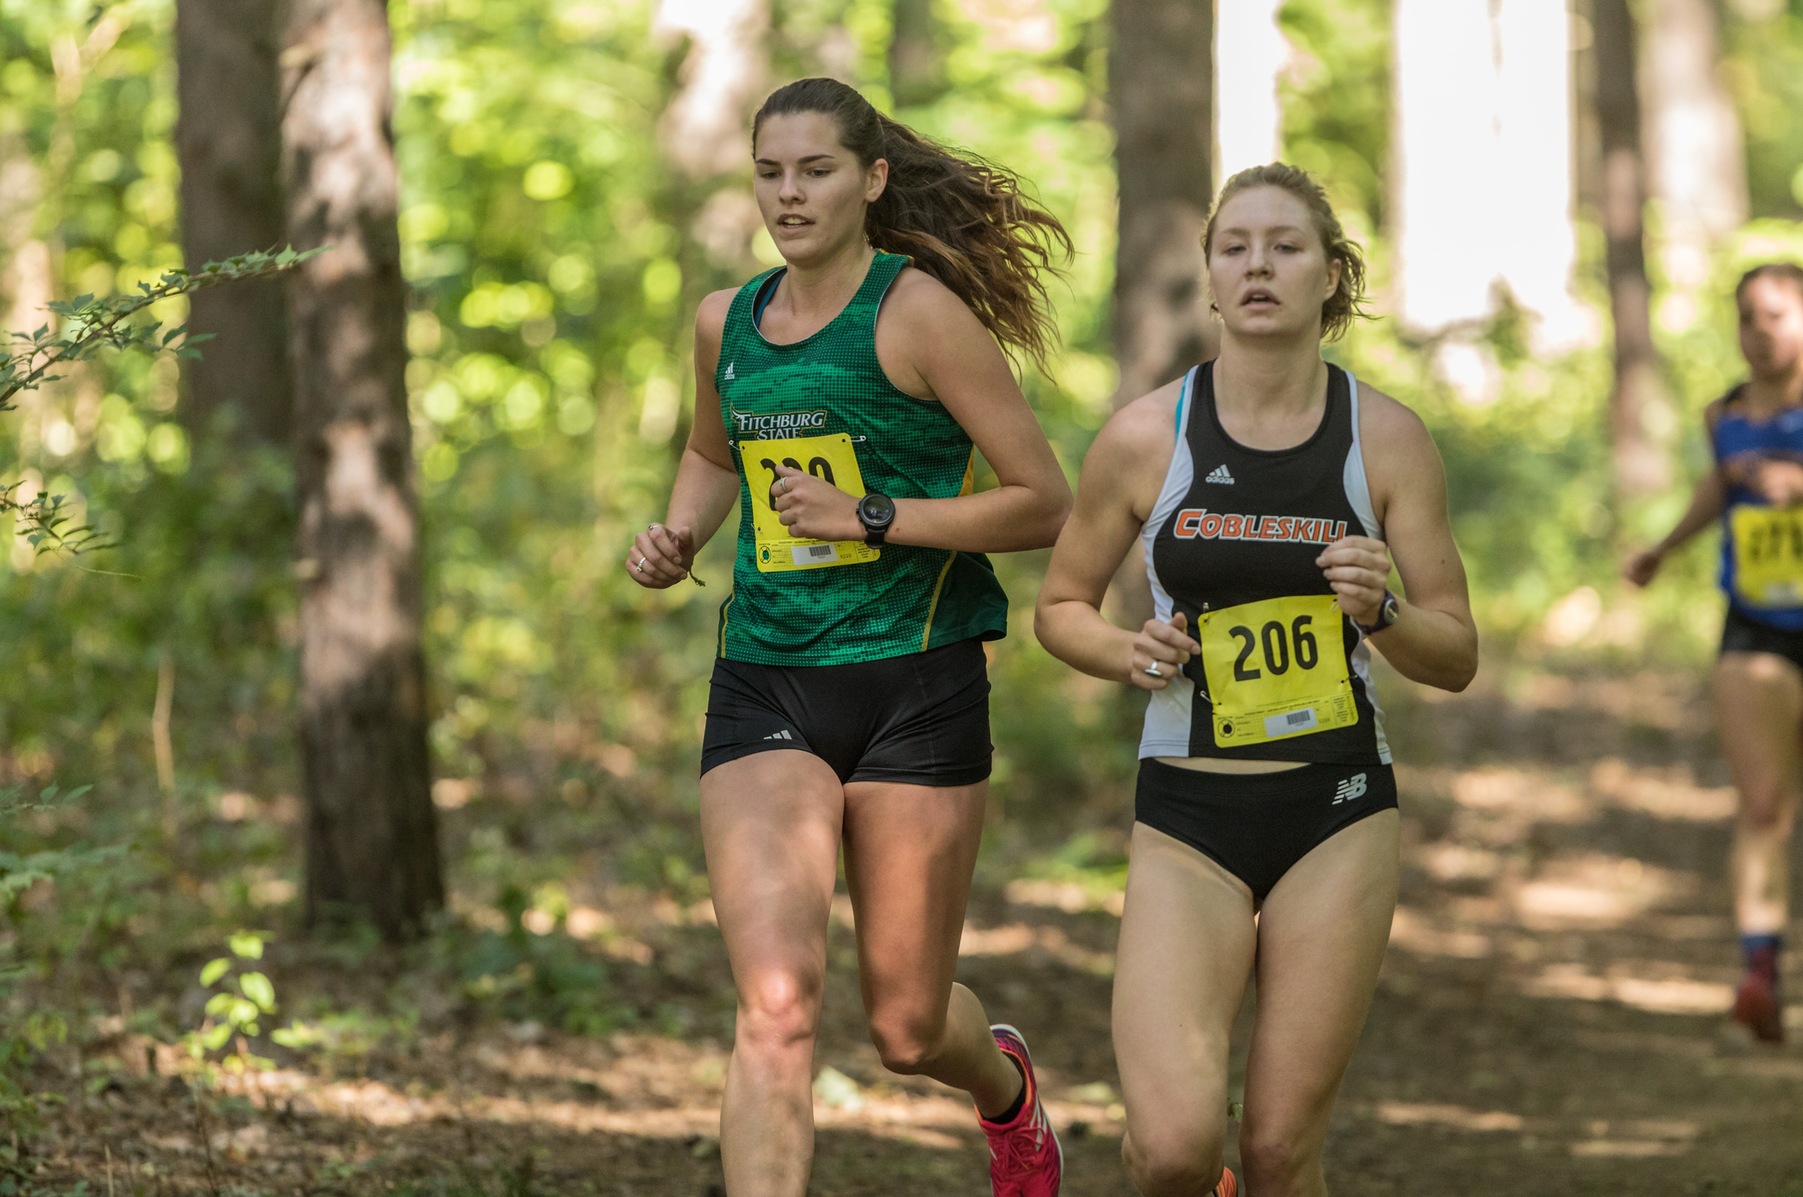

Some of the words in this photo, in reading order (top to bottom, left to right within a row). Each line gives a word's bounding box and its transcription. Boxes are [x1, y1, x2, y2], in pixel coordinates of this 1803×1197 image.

[733, 410, 825, 431] FITCHBURG
[757, 428, 801, 441] STATE
[1228, 614, 1319, 682] 206
